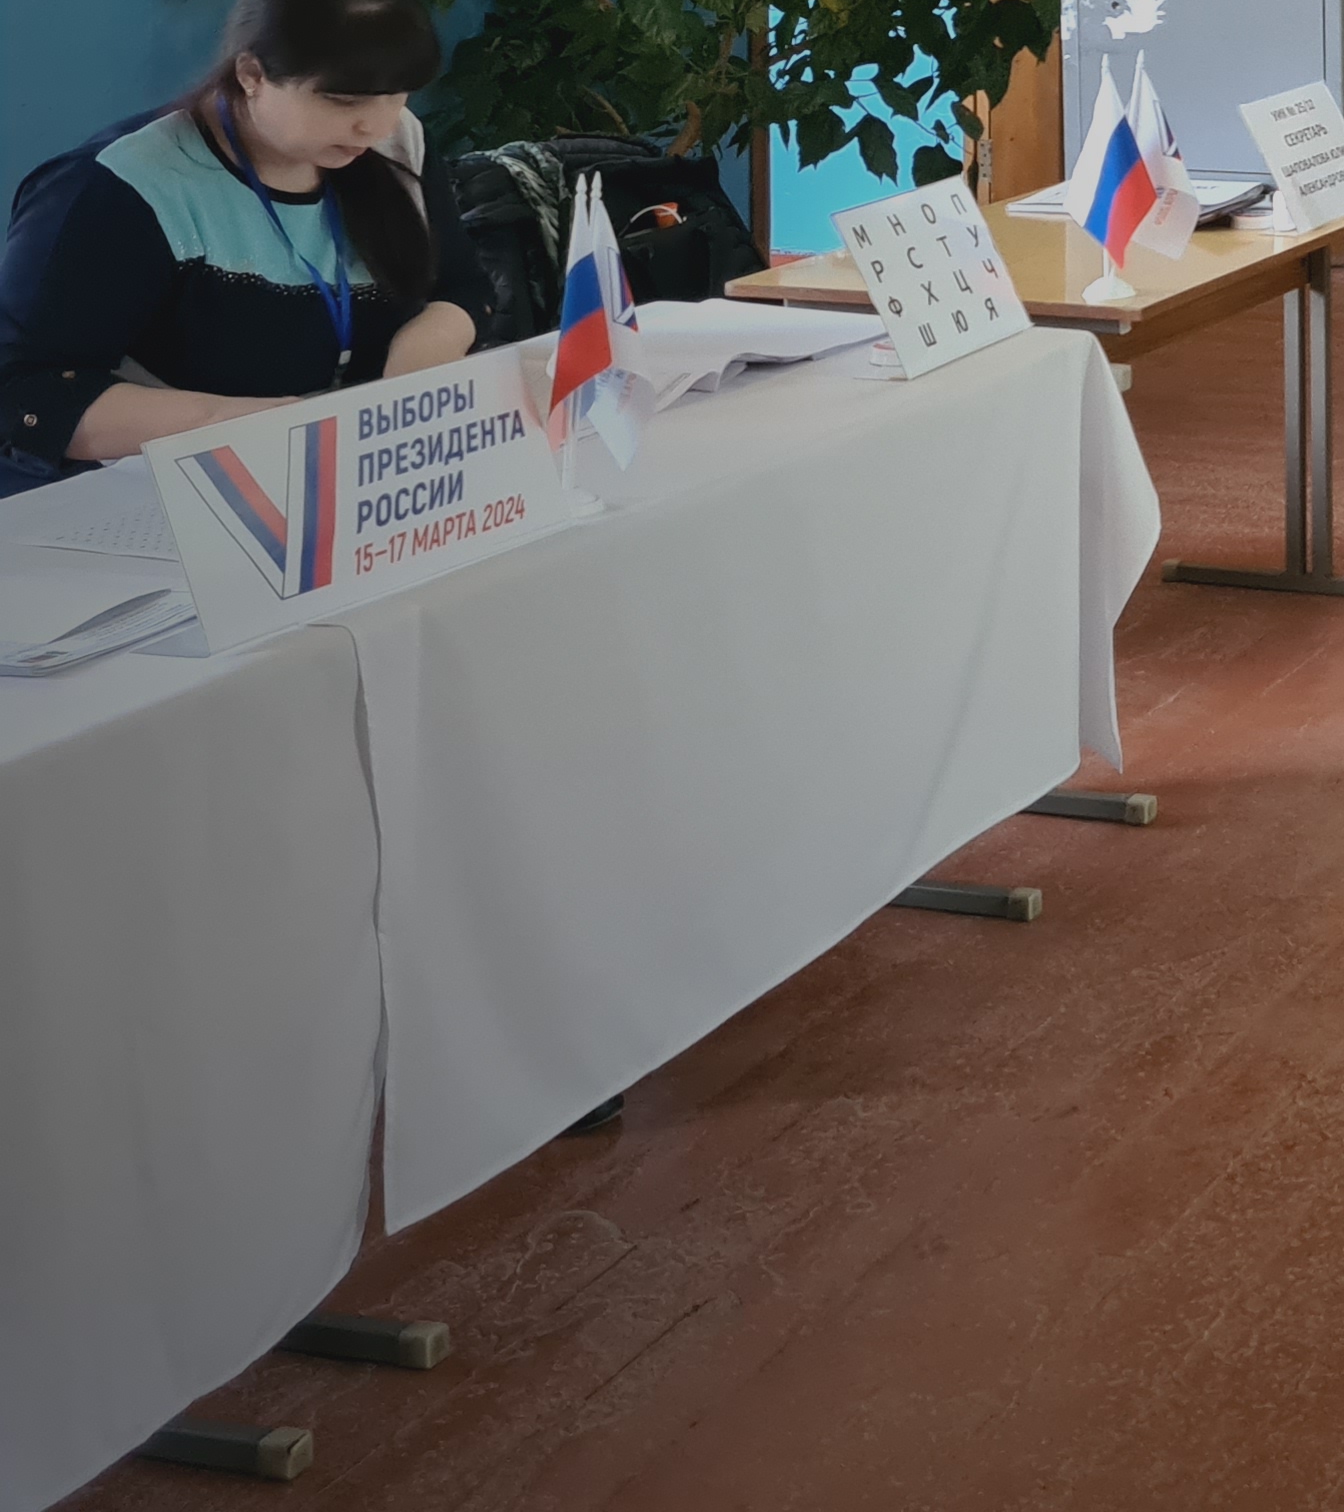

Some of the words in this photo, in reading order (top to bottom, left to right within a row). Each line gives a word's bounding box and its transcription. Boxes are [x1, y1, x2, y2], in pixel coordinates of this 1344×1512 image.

[852, 224, 873, 249] М
[886, 213, 907, 237] Н
[920, 203, 937, 225] О
[950, 193, 967, 216] П
[870, 259, 885, 284] Р
[906, 246, 924, 269] С
[936, 235, 952, 258] Т
[966, 224, 979, 248] У
[887, 295, 903, 318] Ф
[920, 280, 939, 306] Х
[952, 269, 974, 294] Ц
[982, 258, 999, 279] Ч
[918, 322, 937, 348] Ш
[951, 309, 969, 334] Ю
[984, 297, 999, 322] Я
[358, 379, 475, 442] ВЫБОРЫ
[357, 408, 526, 488] ПРЕЗИДЕНТА
[356, 469, 465, 535] РОССИИ
[411, 509, 476, 557] МАРТА
[481, 493, 526, 533] 2024
